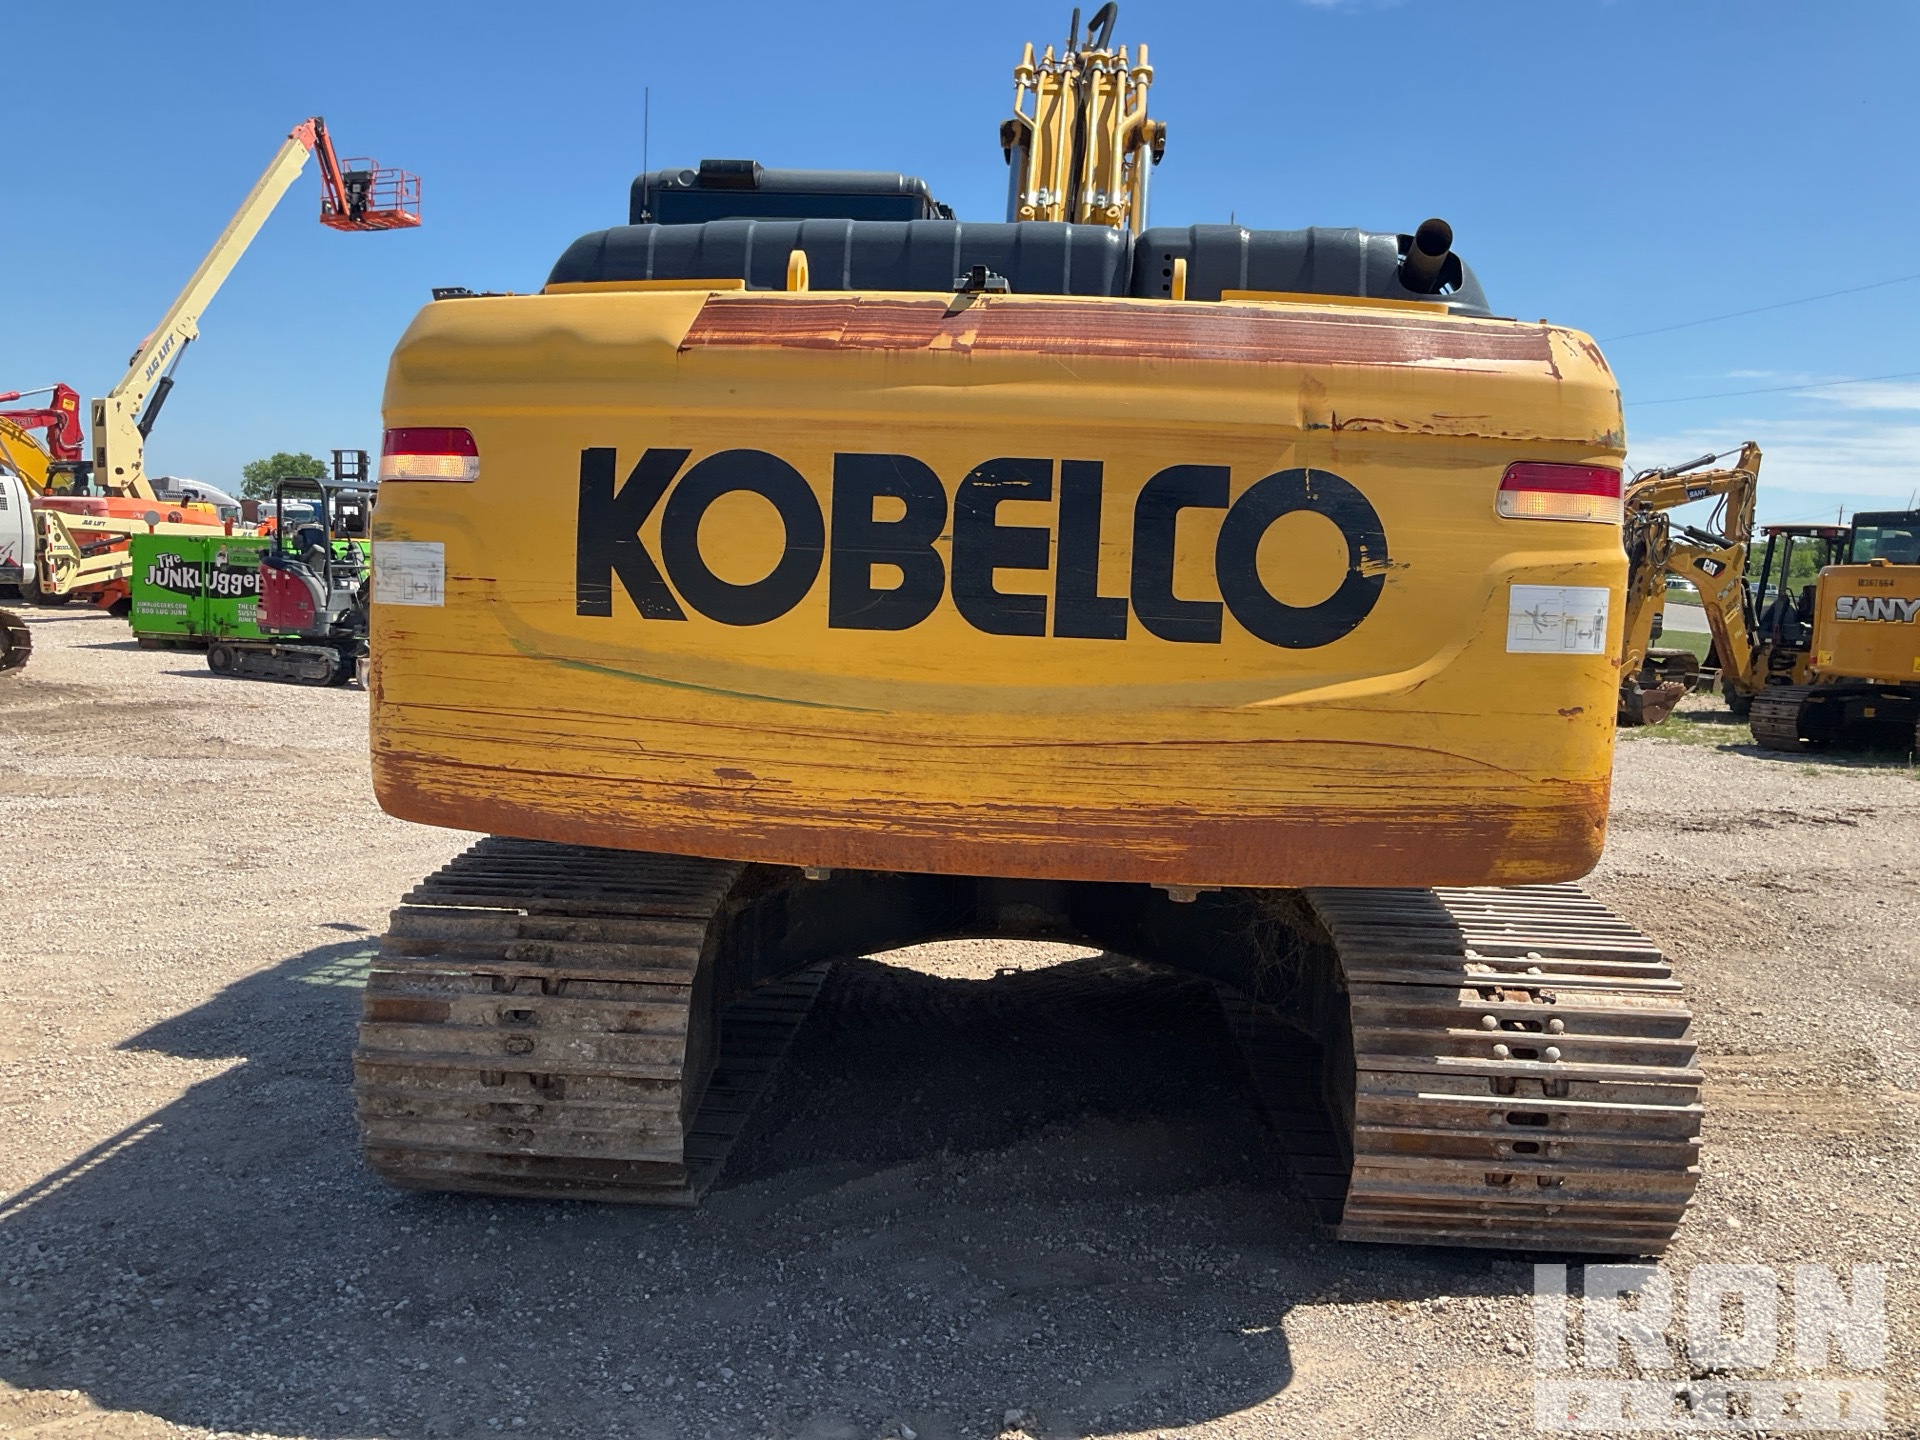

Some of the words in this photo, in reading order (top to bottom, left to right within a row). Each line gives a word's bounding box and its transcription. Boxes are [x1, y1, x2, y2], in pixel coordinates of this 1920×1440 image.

[145, 357, 160, 382] JLG
[158, 333, 176, 361] LIFT
[1689, 489, 1706, 498] SANY
[576, 447, 1389, 649] KOBELCO
[1702, 558, 1718, 576] CAT
[1836, 595, 1920, 623] SANY
